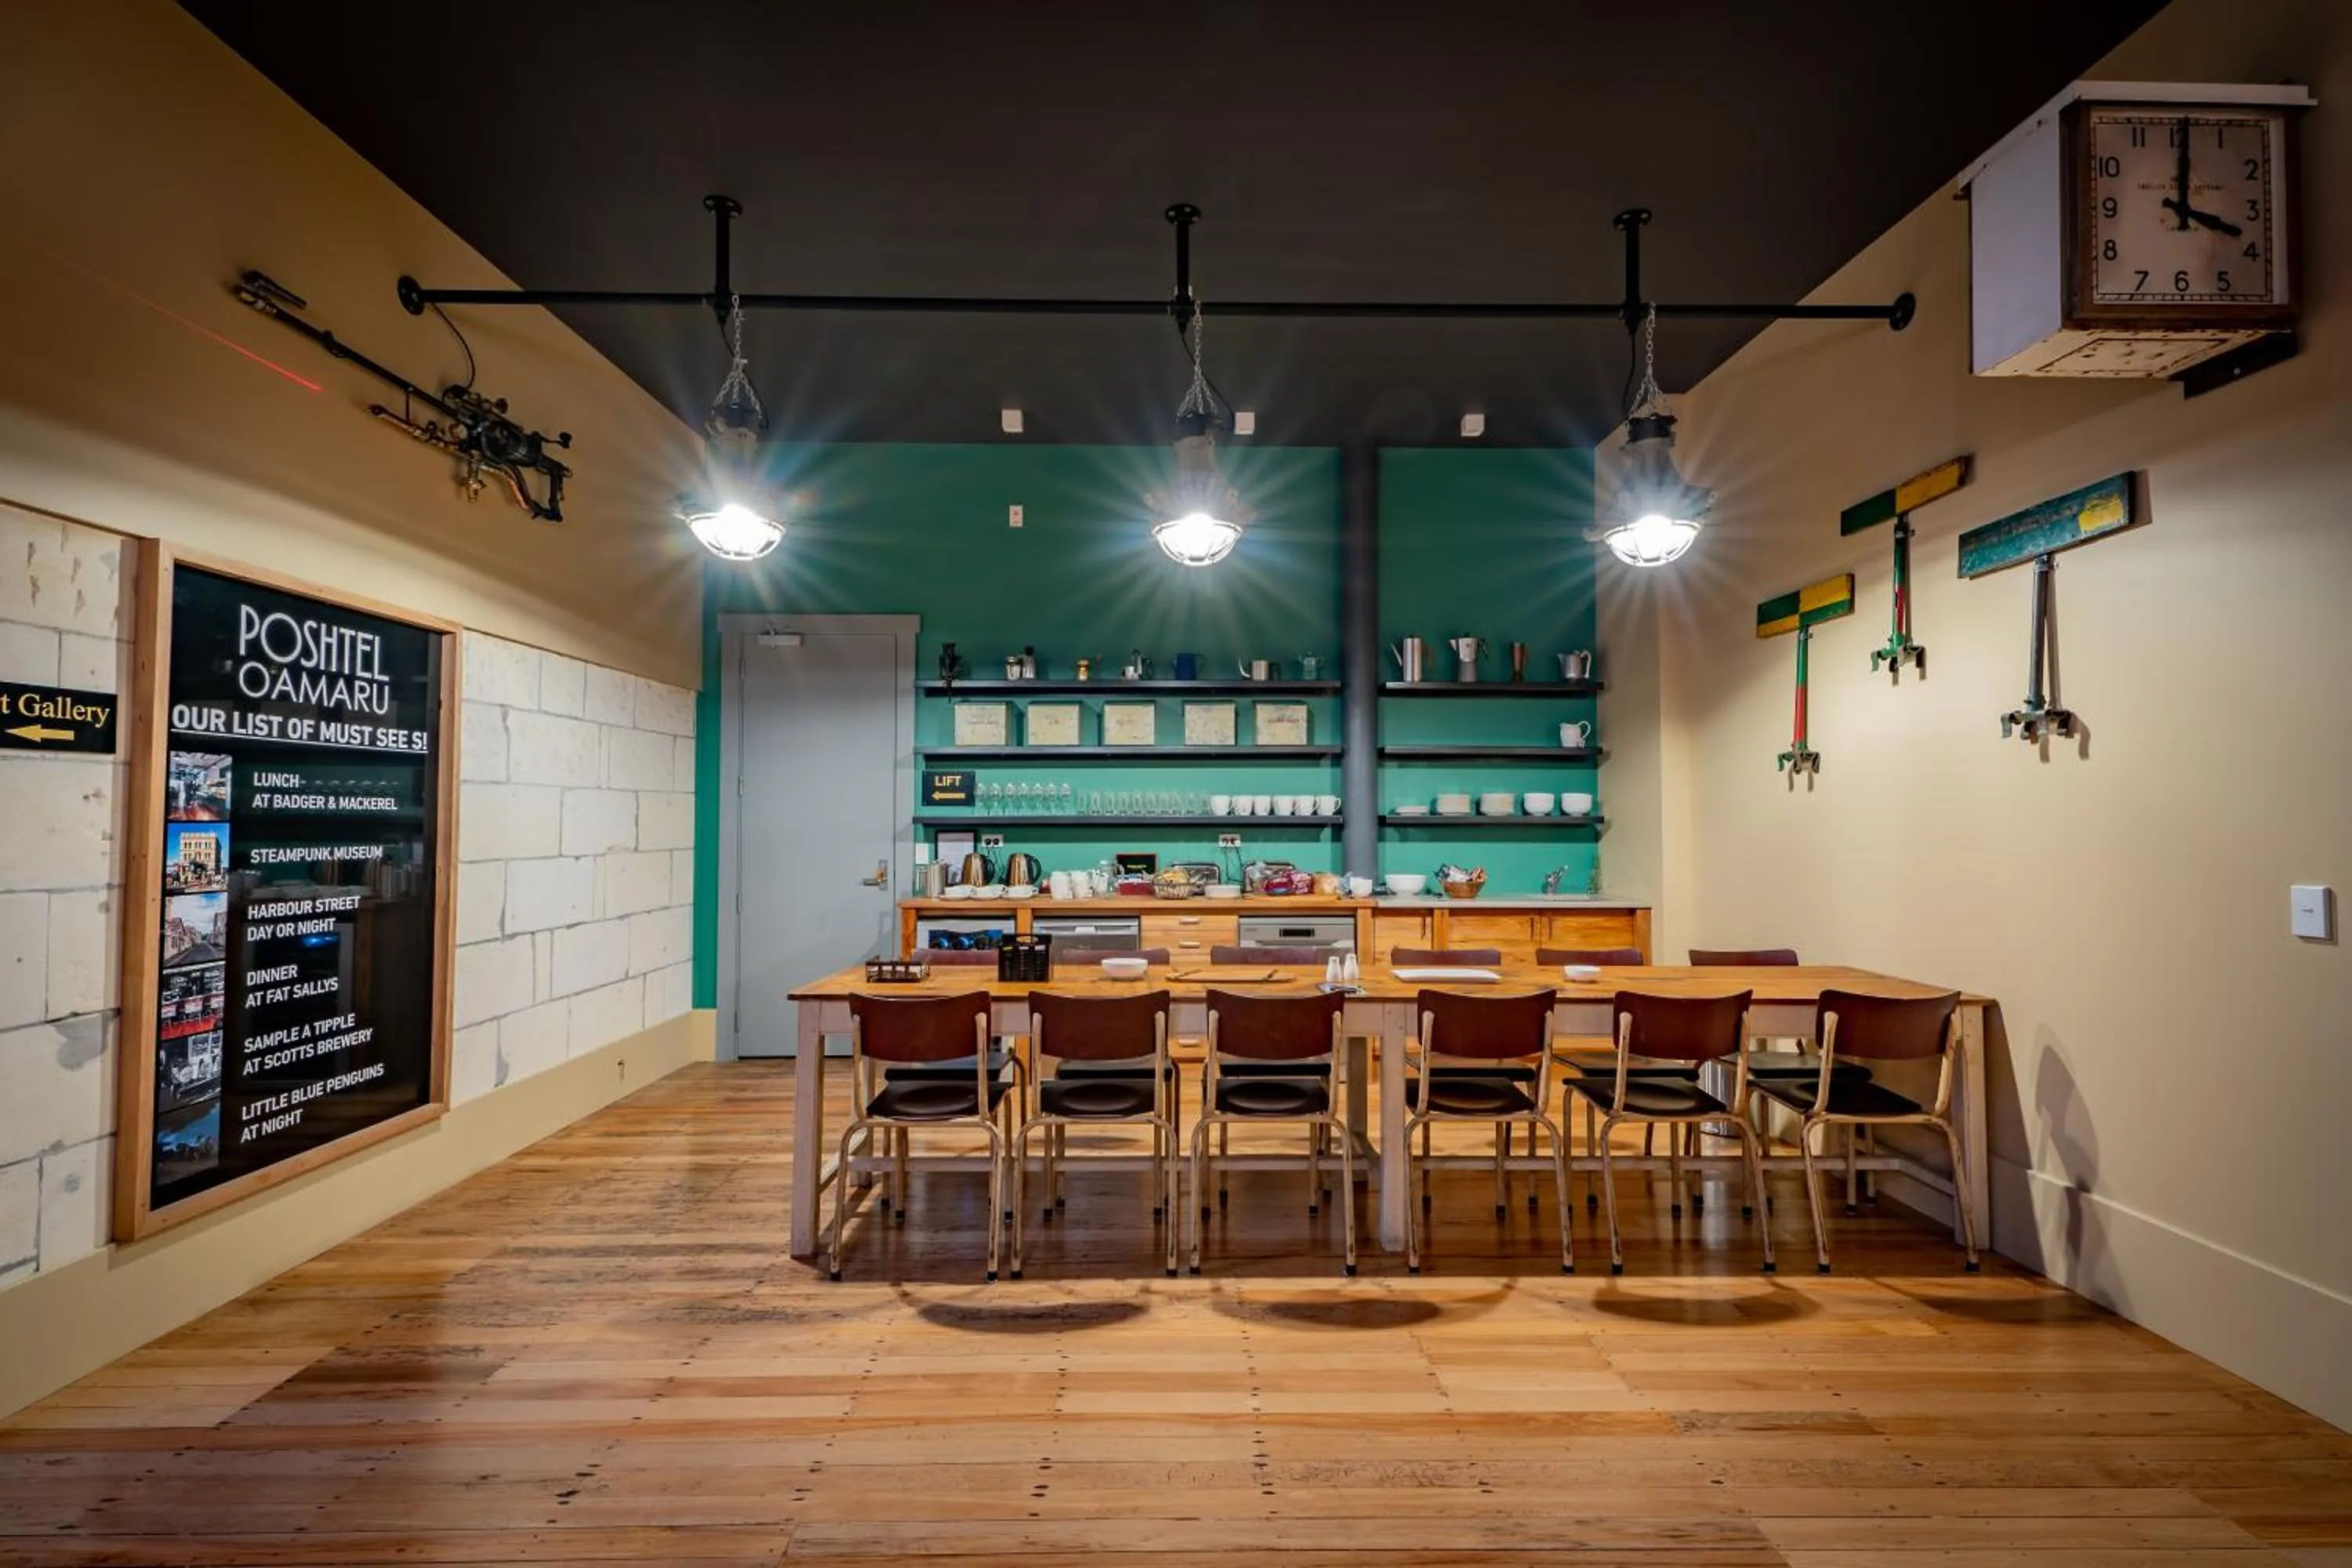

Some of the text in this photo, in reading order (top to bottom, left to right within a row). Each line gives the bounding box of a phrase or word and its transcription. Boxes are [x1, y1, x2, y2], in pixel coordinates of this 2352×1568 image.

[2132, 126, 2146, 147] 11
[2218, 128, 2224, 149] 1
[2099, 157, 2120, 177] 10
[2245, 159, 2259, 180] 2
[2102, 197, 2118, 219] 9
[2246, 201, 2259, 221] 3
[2103, 239, 2118, 260] 8
[2243, 241, 2259, 262] 4
[2134, 271, 2149, 292] 7
[2174, 271, 2190, 292] 6
[2216, 271, 2231, 292] 5
[239, 604, 390, 681] POSHTEL
[238, 661, 390, 715] OAMARU
[18, 693, 111, 728] Gallery
[172, 704, 227, 732] OUR
[233, 711, 283, 737] LIST
[287, 717, 315, 740] OF
[319, 720, 372, 745] MUST
[376, 727, 408, 749] SEE
[935, 775, 962, 786] LIFT
[252, 793, 398, 810] AT BADGER & MACKEREL
[250, 845, 383, 863] STEAMPUNK MUSEUM
[248, 895, 361, 920] HARBOUR STREET
[247, 917, 336, 942] DAY OR NIGHT
[246, 964, 299, 986] DINNER
[245, 977, 339, 1009] AT FAT SALLYS
[244, 1013, 356, 1053] SAMPLE A TIPPLE
[242, 1028, 373, 1076] AT SCOTTS BREWERY
[242, 1063, 384, 1120] LITTLE BLUE PENGUINS
[240, 1109, 303, 1144] AT NIGHT
